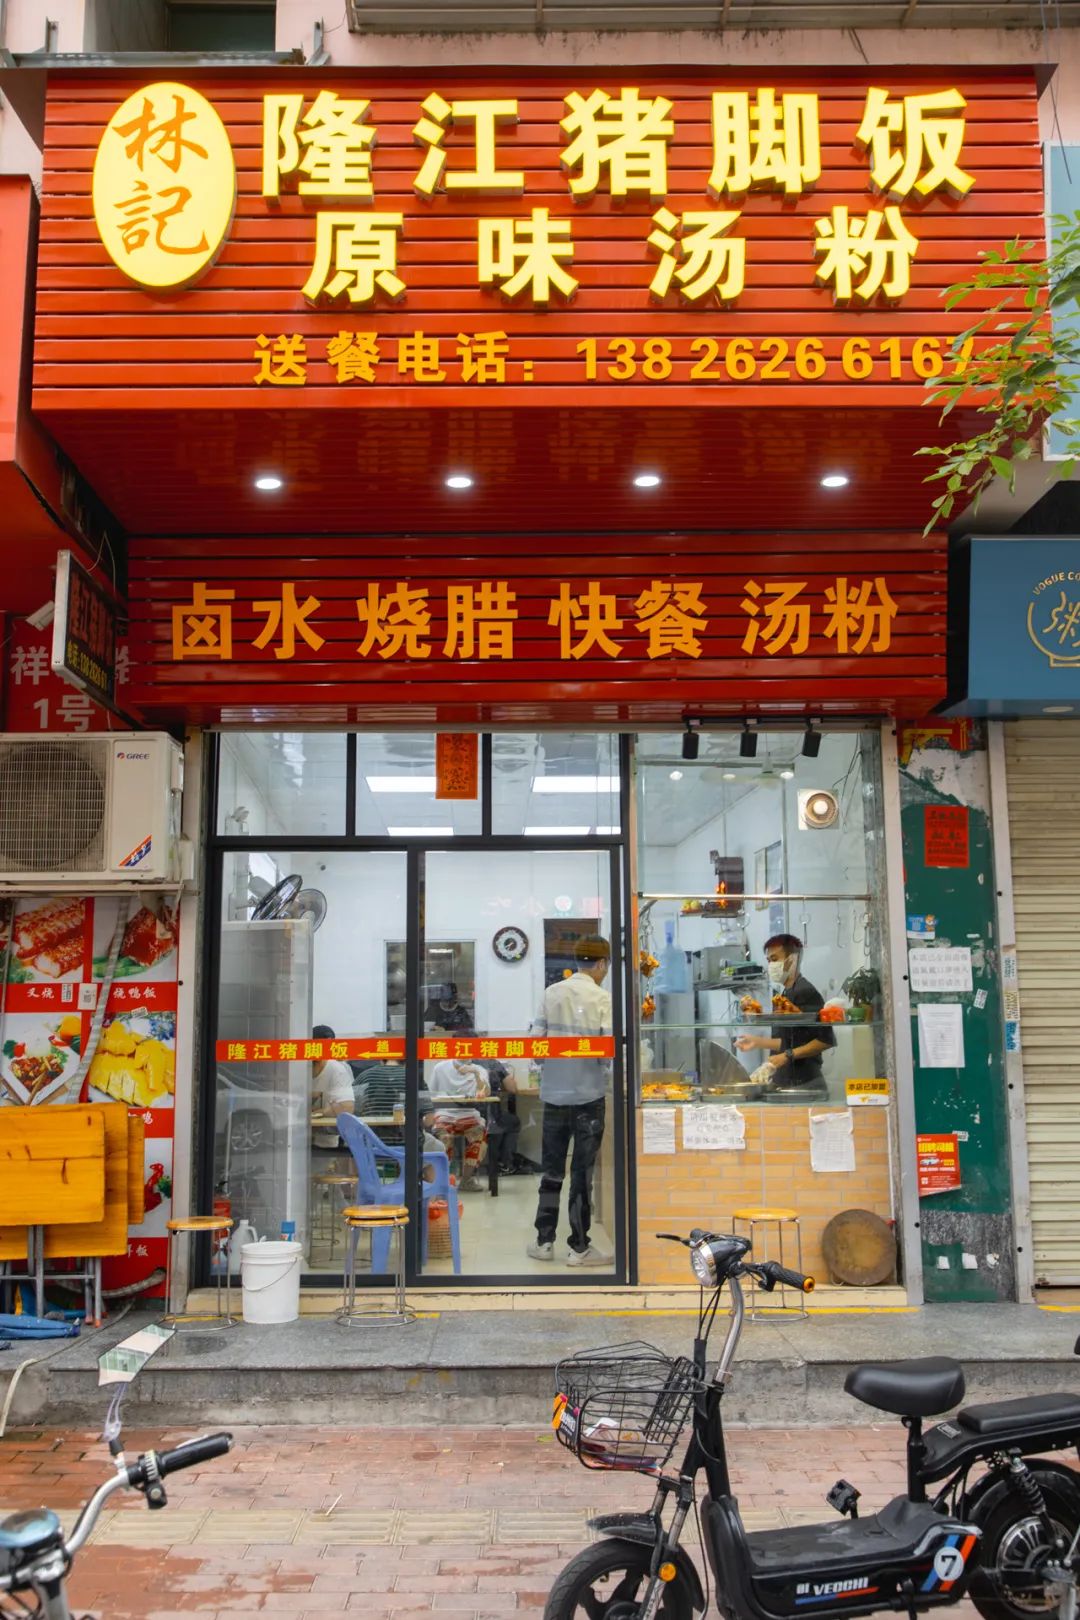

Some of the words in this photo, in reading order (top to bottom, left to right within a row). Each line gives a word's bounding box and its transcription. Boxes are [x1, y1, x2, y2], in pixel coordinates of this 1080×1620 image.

[262, 86, 977, 199] 隆江猪脚饭
[112, 93, 210, 256] 林記
[301, 205, 920, 304] 原味汤粉
[576, 336, 674, 382] 138
[689, 336, 828, 382] 2626
[841, 335, 976, 382] 6167
[1032, 571, 1066, 595] VOGUE
[172, 581, 326, 661] 卤水
[355, 580, 519, 660] 烧腊
[547, 579, 709, 661] 快餐
[739, 576, 899, 656] 汤粉
[227, 1042, 349, 1060] 隆江猪脚饭
[428, 1040, 550, 1058] 隆江猪脚饭
[940, 1555, 958, 1578] 7
